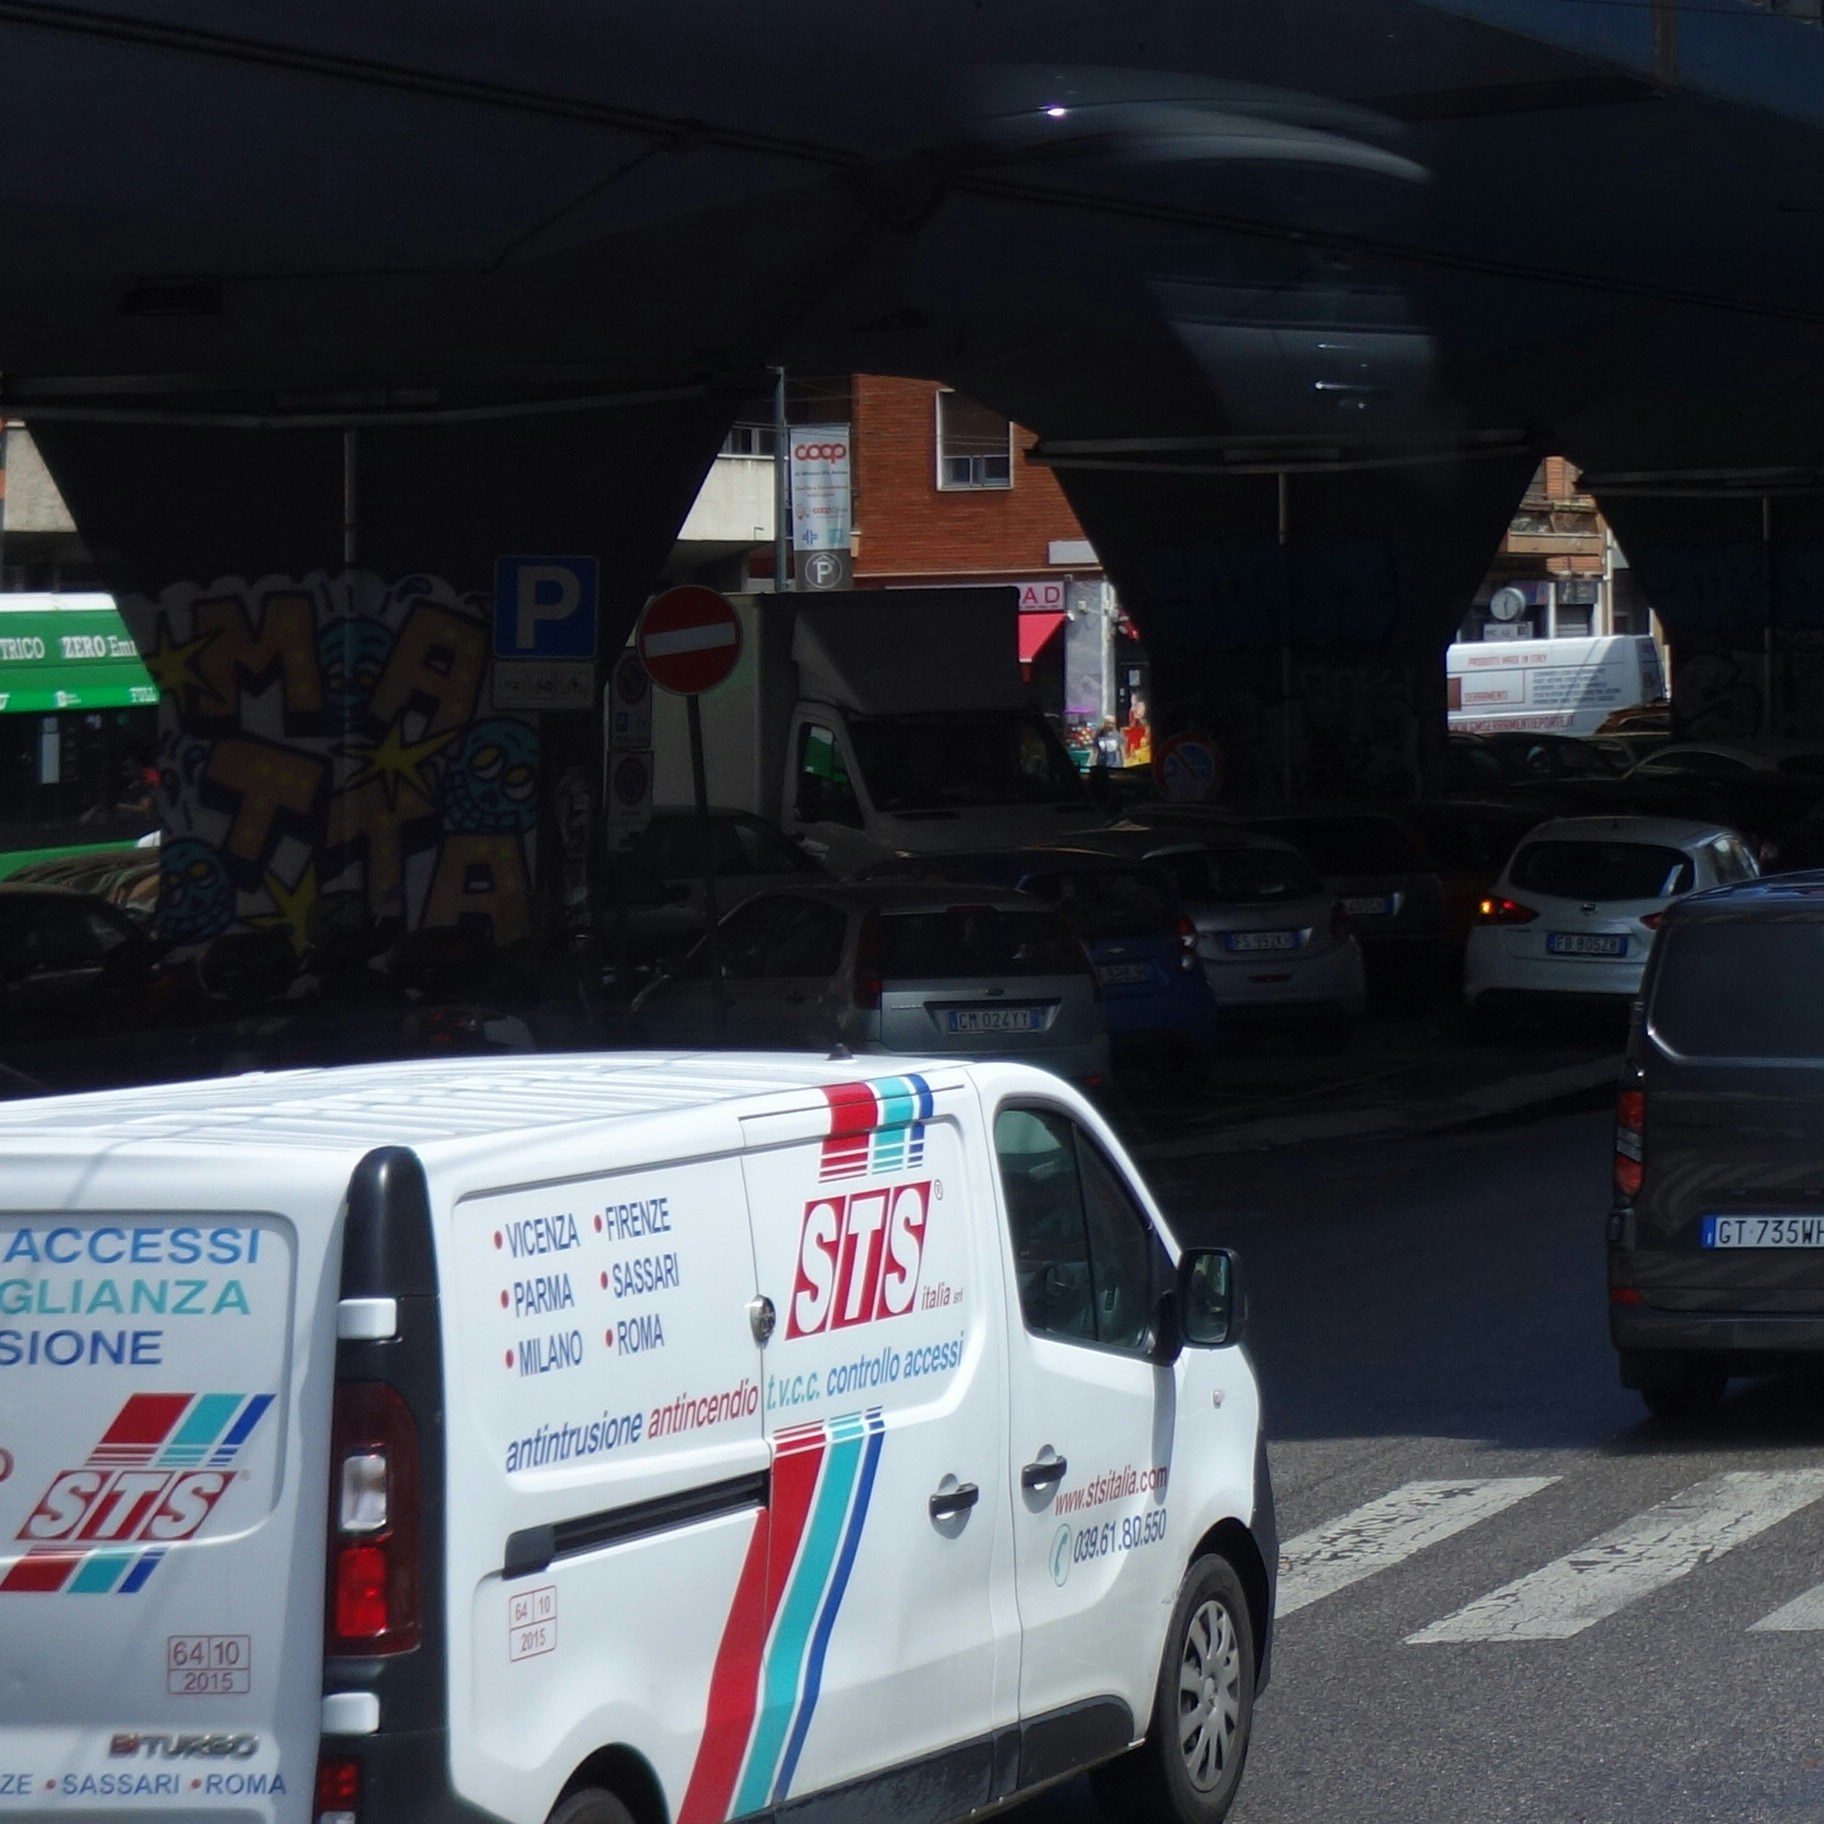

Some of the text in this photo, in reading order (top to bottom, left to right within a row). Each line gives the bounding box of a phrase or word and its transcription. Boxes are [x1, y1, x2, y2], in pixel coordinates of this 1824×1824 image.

[795, 443, 846, 464] coop
[516, 565, 582, 649] P
[62, 635, 106, 659] ZERO
[3, 1227, 260, 1264] ACCESSI
[505, 1197, 671, 1259] VICENZA FIRENZE
[1718, 1220, 1746, 1244] GT
[784, 1179, 932, 1341] STS
[0, 1278, 250, 1315] GLIANZA
[514, 1252, 680, 1318] PARMA SASSARI
[921, 1281, 951, 1311] italia
[518, 1313, 665, 1377] MILANO ROMA
[505, 1410, 643, 1474] antintrusione
[648, 1377, 759, 1440] antincendio
[826, 1346, 900, 1397] controllo
[903, 1330, 965, 1377] accessi
[16, 1470, 238, 1541] STS
[1055, 1463, 1168, 1517] www.stsitalia.com
[1073, 1507, 1167, 1564] 039.61.80.550
[515, 1595, 551, 1621] 64 10
[172, 1641, 240, 1667] 64 10
[520, 1627, 546, 1653] 2015
[184, 1672, 234, 1693] 2015
[61, 1774, 181, 1796] SASSARI
[205, 1774, 287, 1796] ROMA
